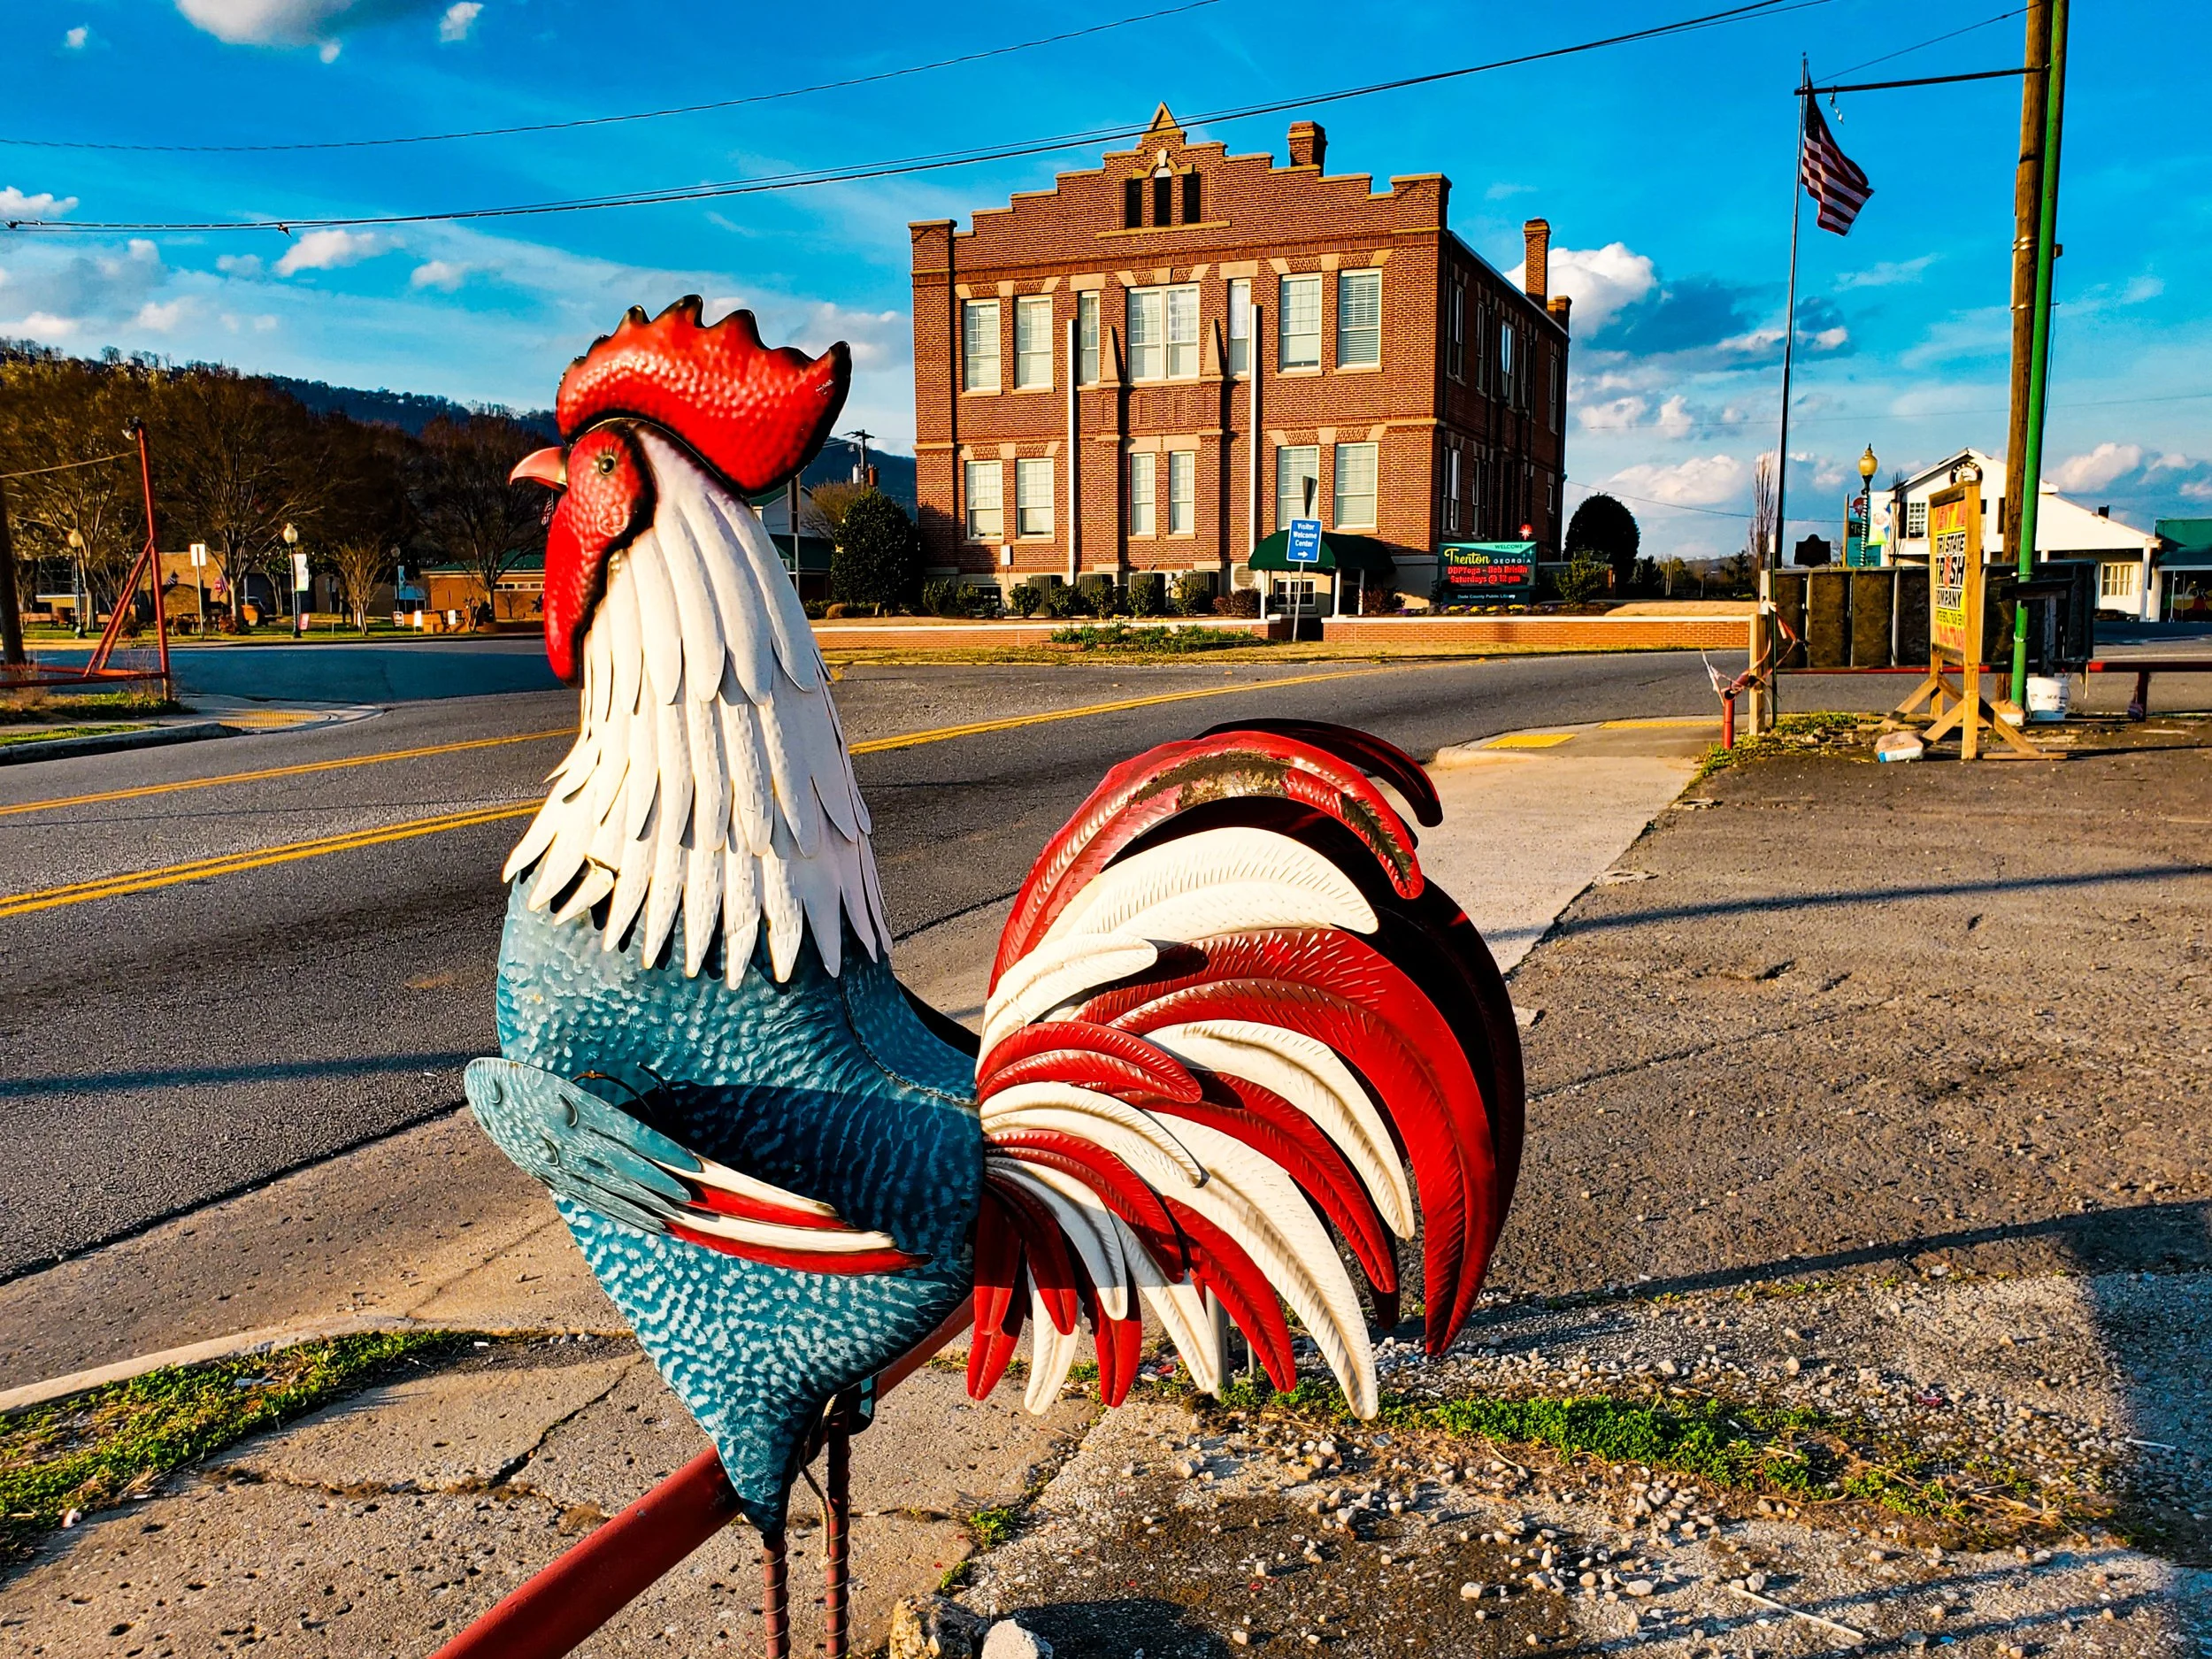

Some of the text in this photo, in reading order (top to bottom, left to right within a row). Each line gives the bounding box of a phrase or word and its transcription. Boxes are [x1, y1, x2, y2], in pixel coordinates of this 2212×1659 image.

[1946, 534, 1965, 553] STATE
[1444, 548, 1491, 565] Trenton
[1450, 575, 1487, 584] Saturdays
[1488, 575, 1497, 584] @
[1936, 556, 1965, 586] TRSH
[1936, 589, 1962, 608] OMPANY
